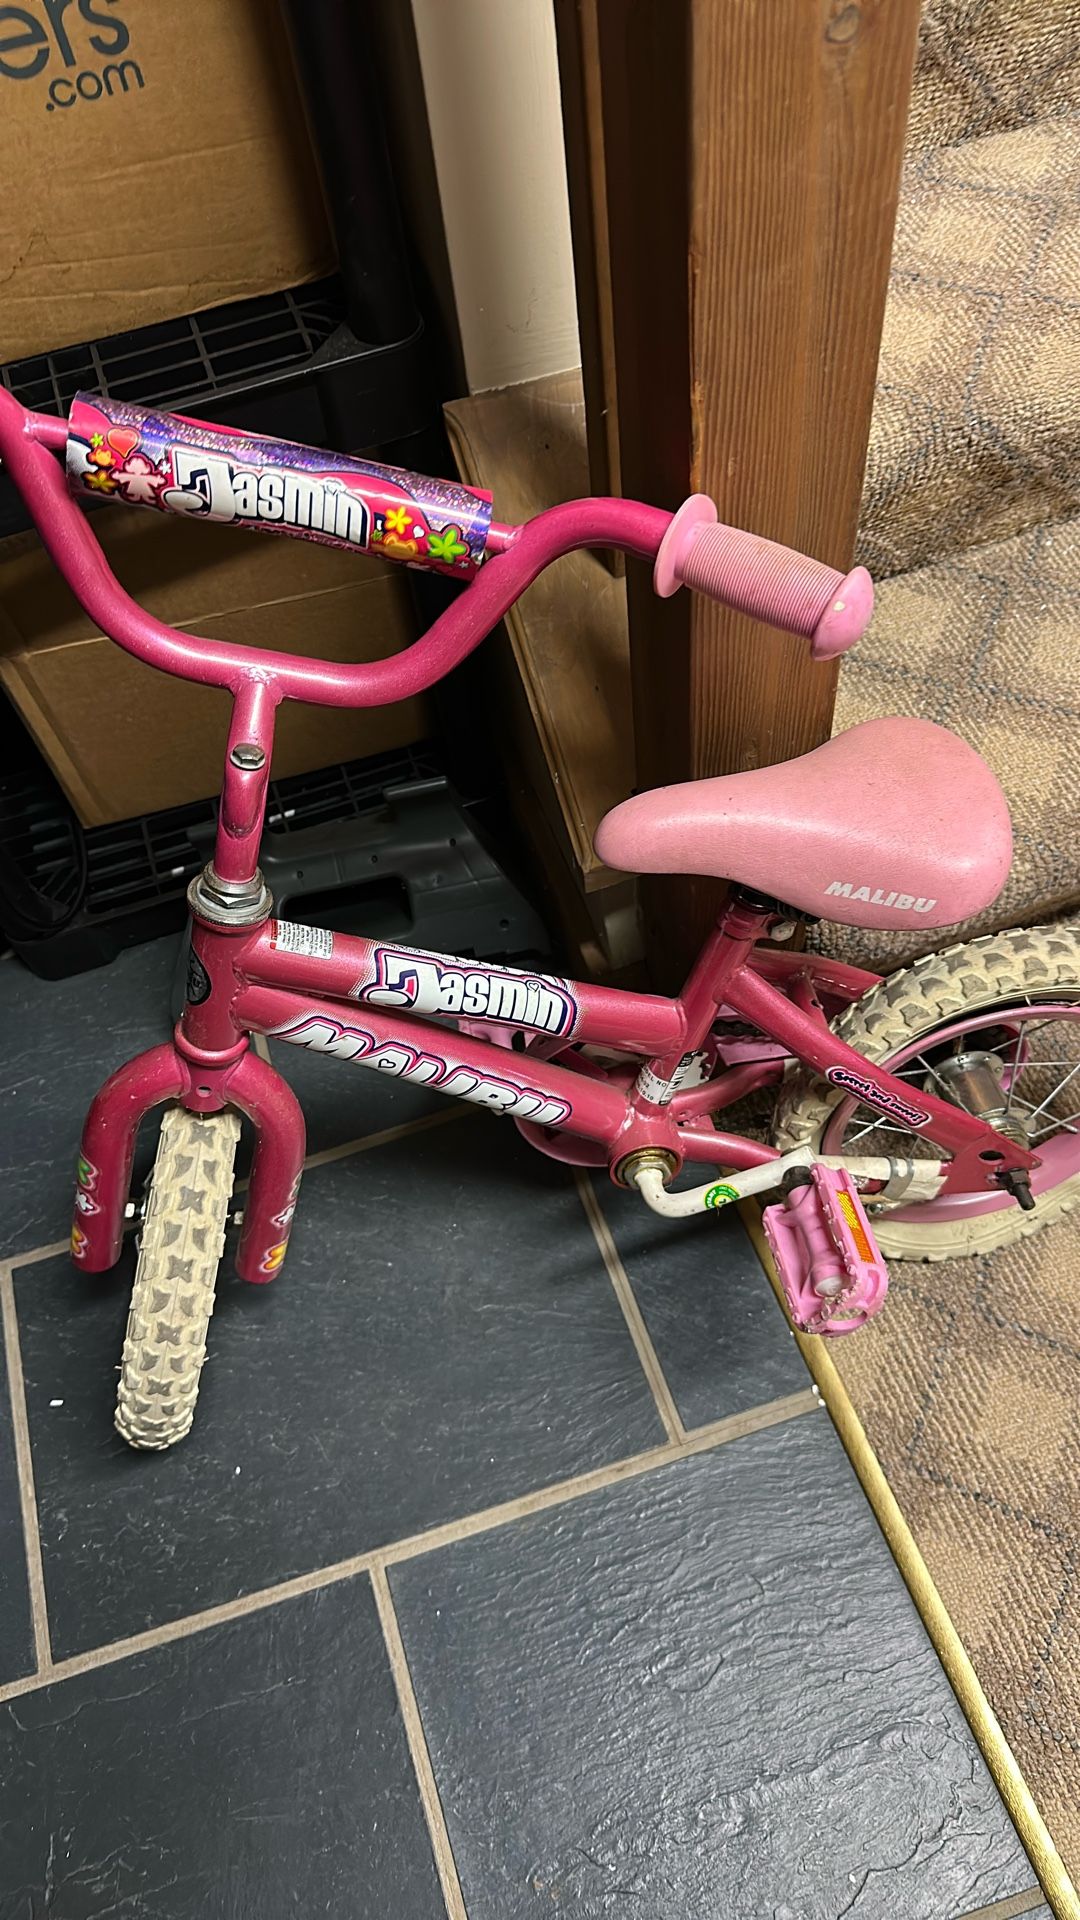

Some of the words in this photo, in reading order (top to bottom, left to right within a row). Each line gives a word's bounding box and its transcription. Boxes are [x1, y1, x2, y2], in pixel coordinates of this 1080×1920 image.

[46, 60, 145, 111] .com
[162, 450, 365, 545] Jasmin
[823, 881, 937, 913] MALIBU
[367, 954, 564, 1032] Jasmin
[280, 1022, 566, 1126] MALIBU
